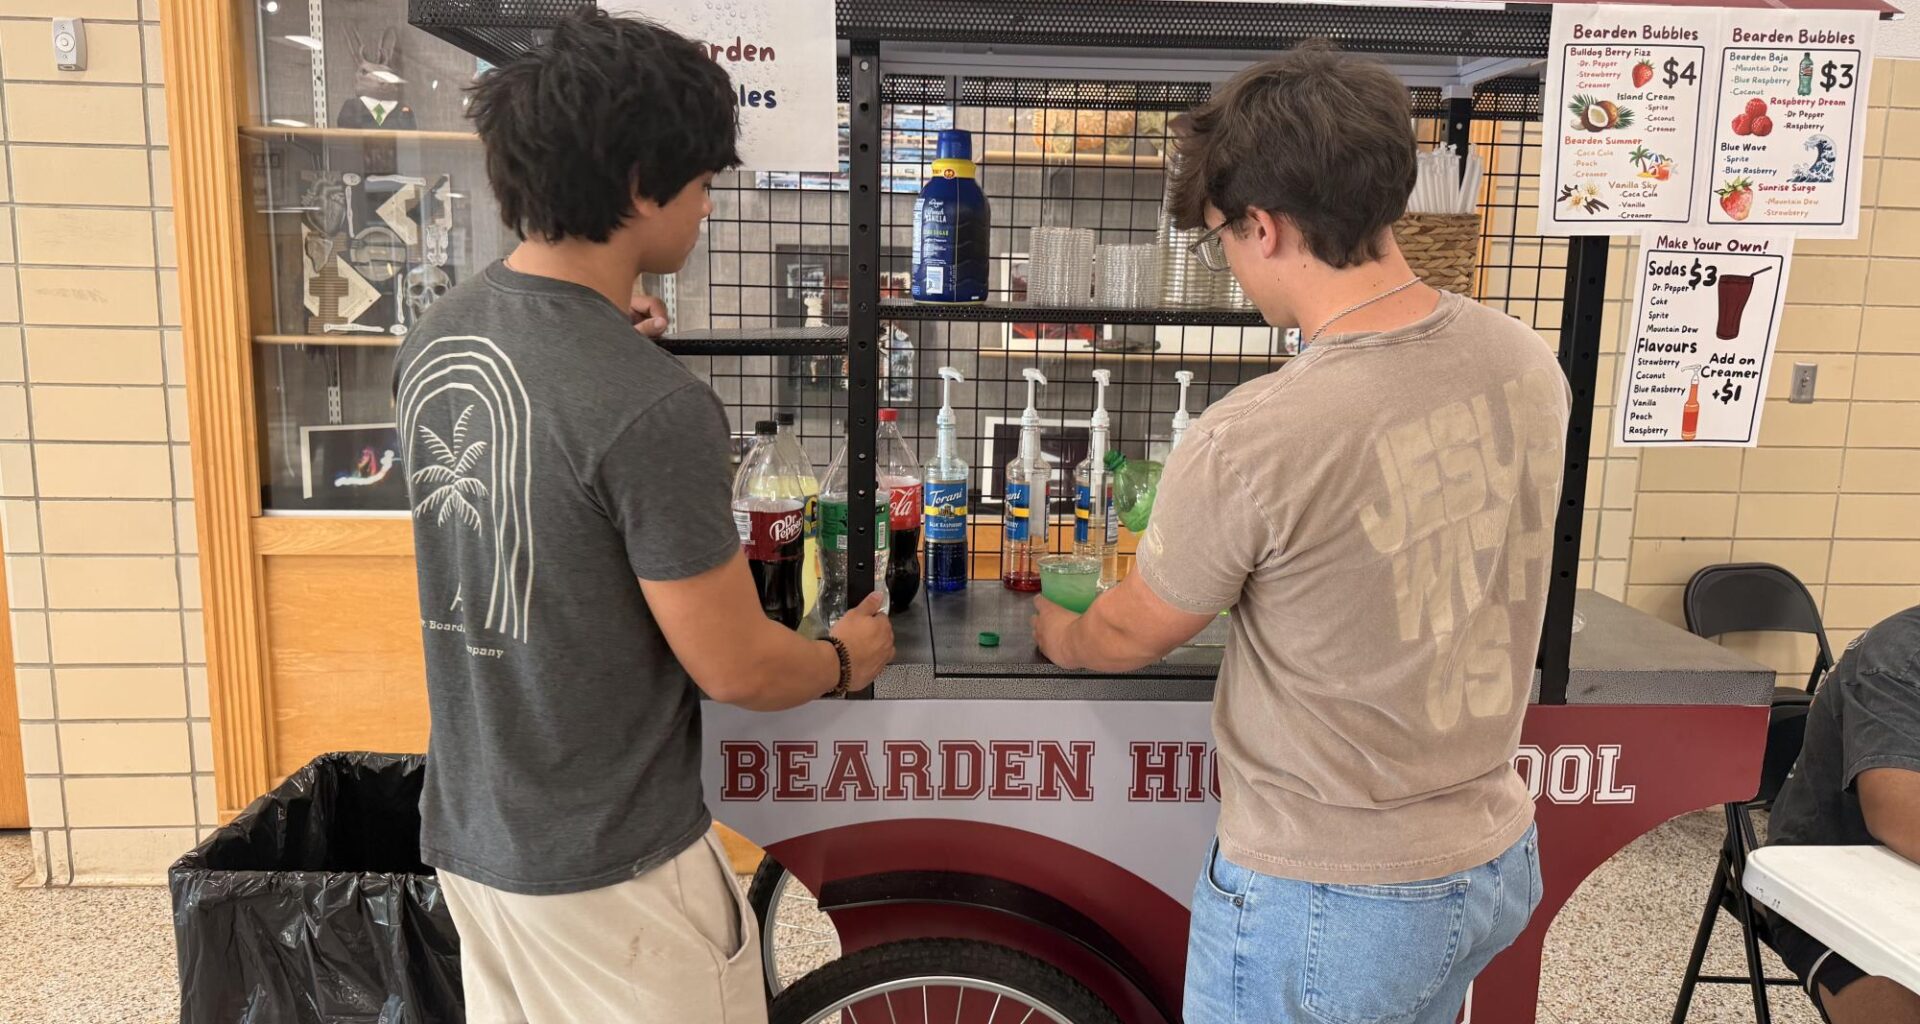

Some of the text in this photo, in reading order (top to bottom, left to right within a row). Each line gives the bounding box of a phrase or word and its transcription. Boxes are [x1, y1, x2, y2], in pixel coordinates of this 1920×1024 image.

[1573, 24, 1698, 40] Bearden Bubbles
[1732, 28, 1855, 44] Bearden Bubbles
[1570, 47, 1651, 59] Bulldog Berry Fizz
[1730, 52, 1788, 62] Bearden Baja
[1662, 57, 1696, 89] $4
[1820, 61, 1853, 92] $3
[1752, 77, 1791, 85] Raspberry
[1617, 93, 1675, 101] Island Cream
[1770, 97, 1845, 108] Raspberry Dream
[1799, 111, 1824, 119] Pepper
[1565, 136, 1642, 145] Bearden Summer
[1721, 143, 1739, 151] Blue
[1743, 168, 1777, 176] Rasberry
[1642, 182, 1657, 192] Sky
[1792, 184, 1816, 193] Surge
[1656, 235, 1769, 254] Make Your Own!
[1648, 258, 1717, 290] Sodas $3
[1664, 284, 1689, 294] Pepper
[1651, 297, 1667, 306] Coke
[1648, 311, 1669, 321] Sprite
[1646, 325, 1680, 333] Mountain
[1637, 338, 1697, 354] Flavours
[1638, 358, 1680, 367] Strawberry
[1710, 353, 1755, 365] Add on
[1636, 372, 1665, 380] Coconut
[1701, 366, 1759, 378] Creamer
[1634, 385, 1686, 396] Blue Rasberry
[1712, 379, 1742, 405] +$1
[1629, 426, 1668, 436] Raspberry
[1359, 366, 1565, 554] JESUS
[930, 488, 963, 507] Torani
[785, 514, 797, 528] Dr
[775, 518, 802, 541] Pepper
[1425, 604, 1513, 732] US
[720, 739, 1096, 802] BEARDEN
